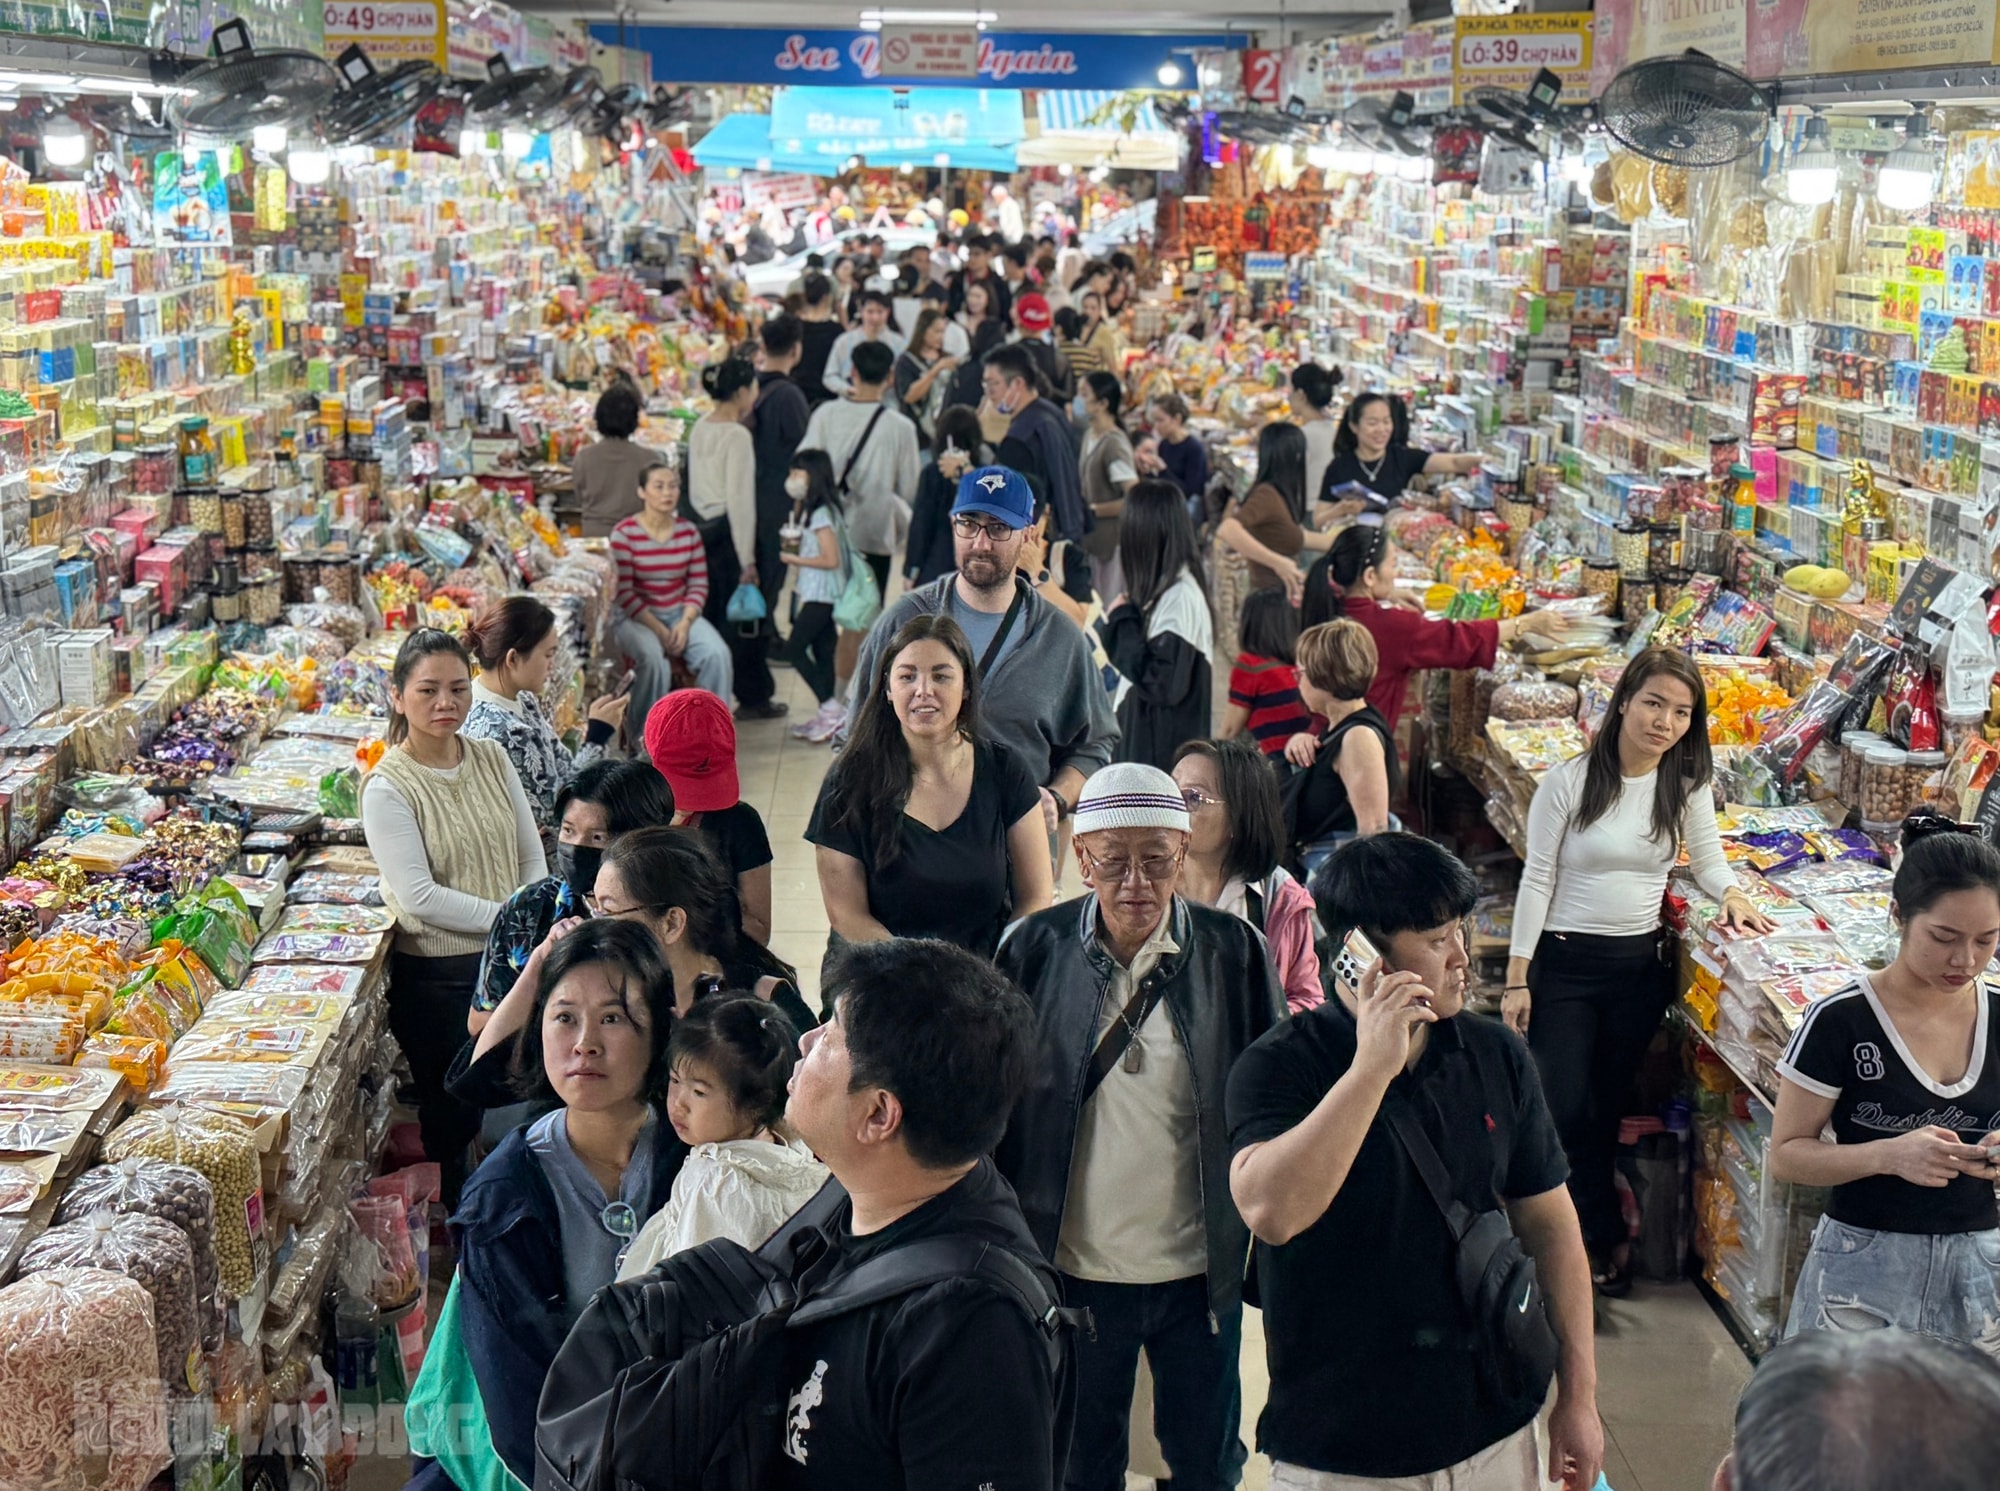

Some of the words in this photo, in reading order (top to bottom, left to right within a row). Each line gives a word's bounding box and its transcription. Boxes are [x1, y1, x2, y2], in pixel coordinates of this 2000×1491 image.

[346, 6, 375, 31] 49
[775, 34, 841, 71] See
[1491, 39, 1519, 63] 39
[1521, 46, 1549, 66] CHỢ
[1550, 44, 1578, 62] HÀN
[1253, 56, 1275, 99] 2
[1854, 1041, 1885, 1081] 8
